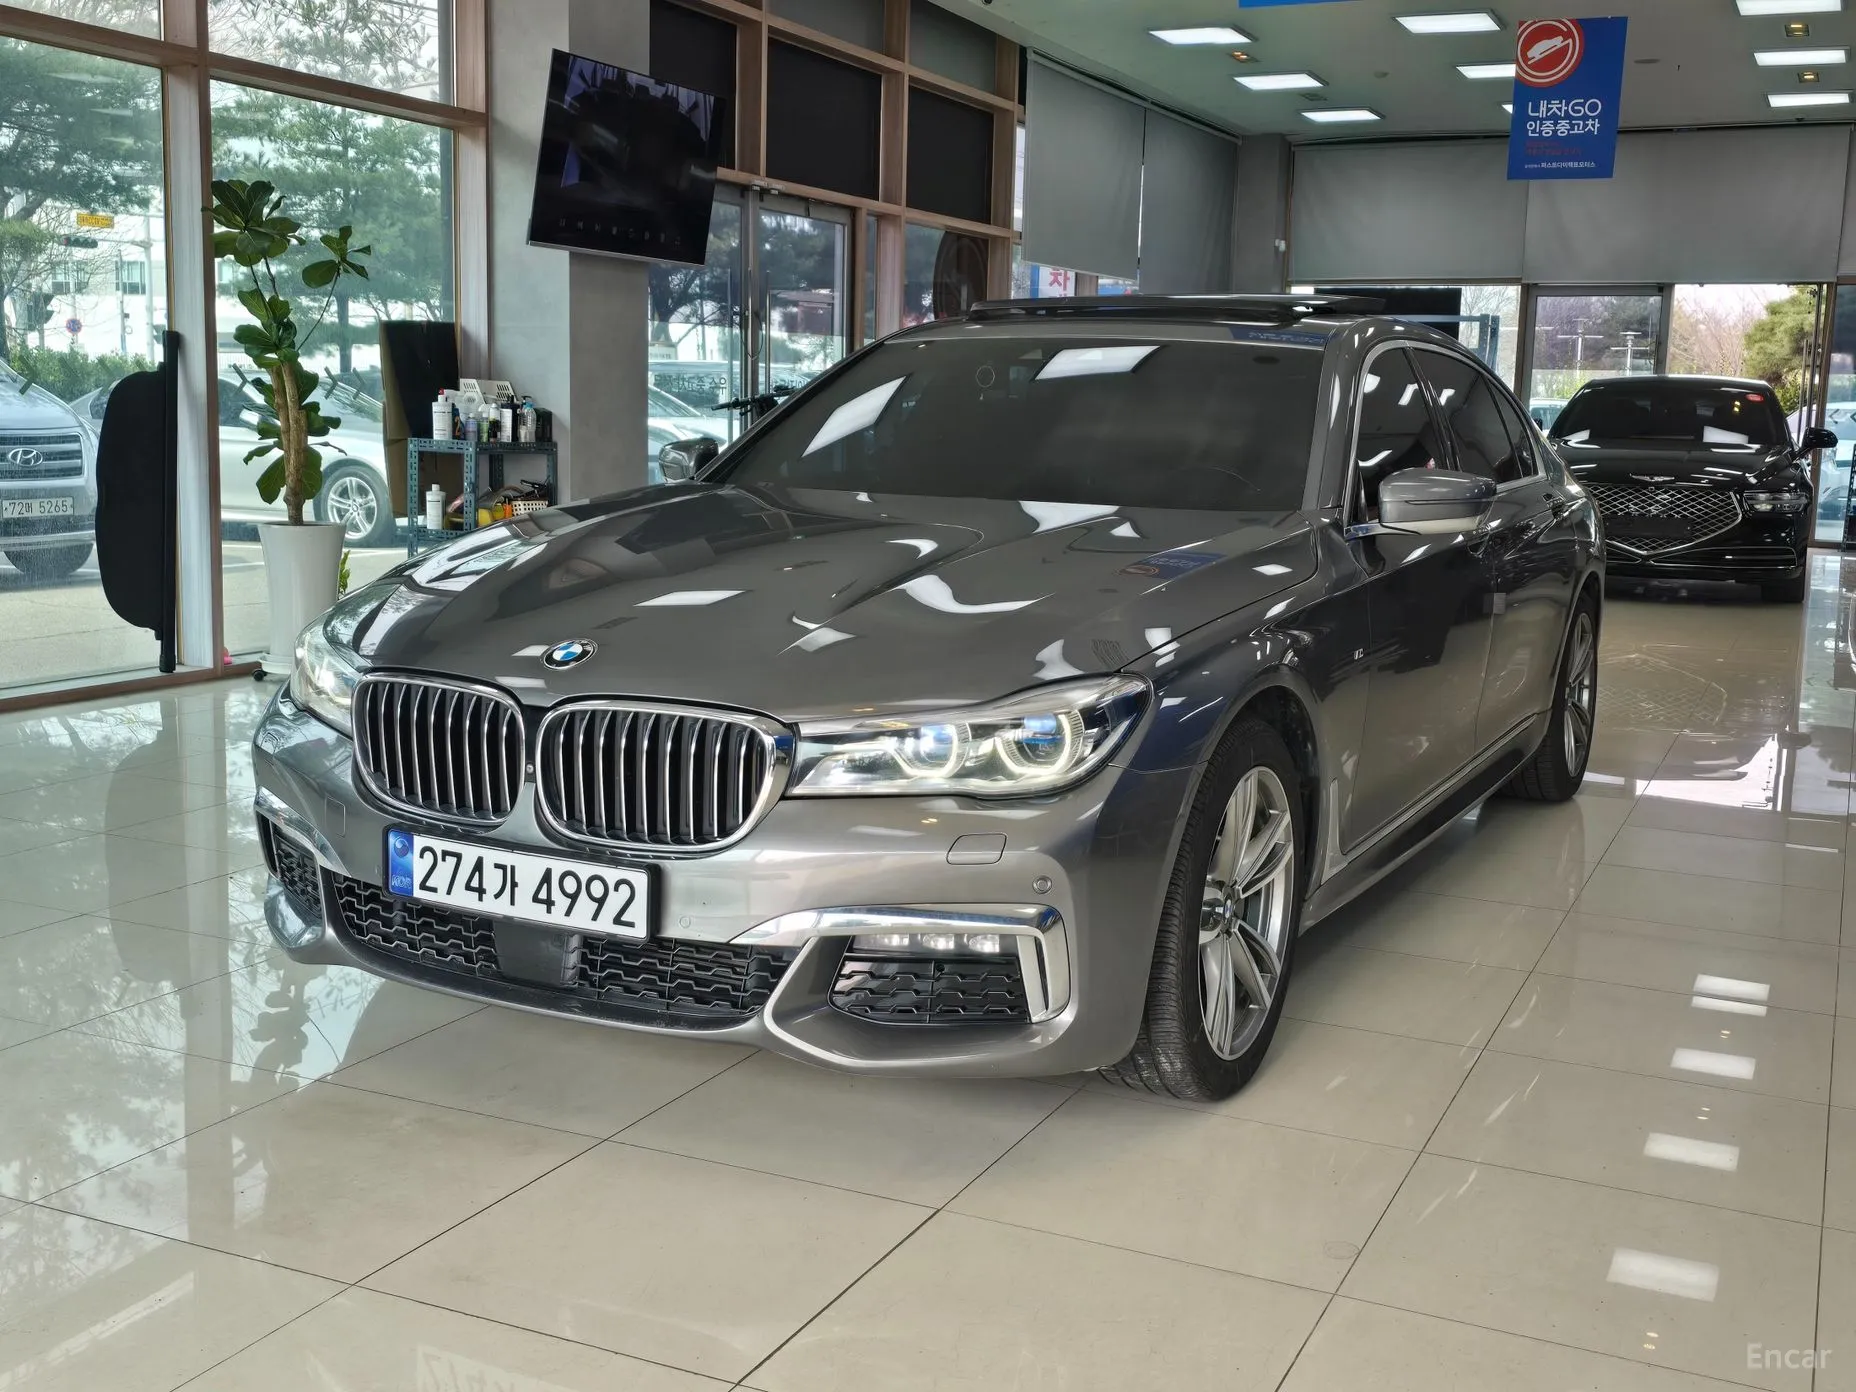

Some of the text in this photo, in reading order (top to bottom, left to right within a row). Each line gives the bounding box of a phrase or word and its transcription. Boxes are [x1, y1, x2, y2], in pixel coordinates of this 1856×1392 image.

[1528, 98, 1602, 118] 내차GO
[1526, 118, 1601, 137] 인증중고차
[39, 500, 68, 514] 5265
[418, 845, 636, 928] 274가 4992
